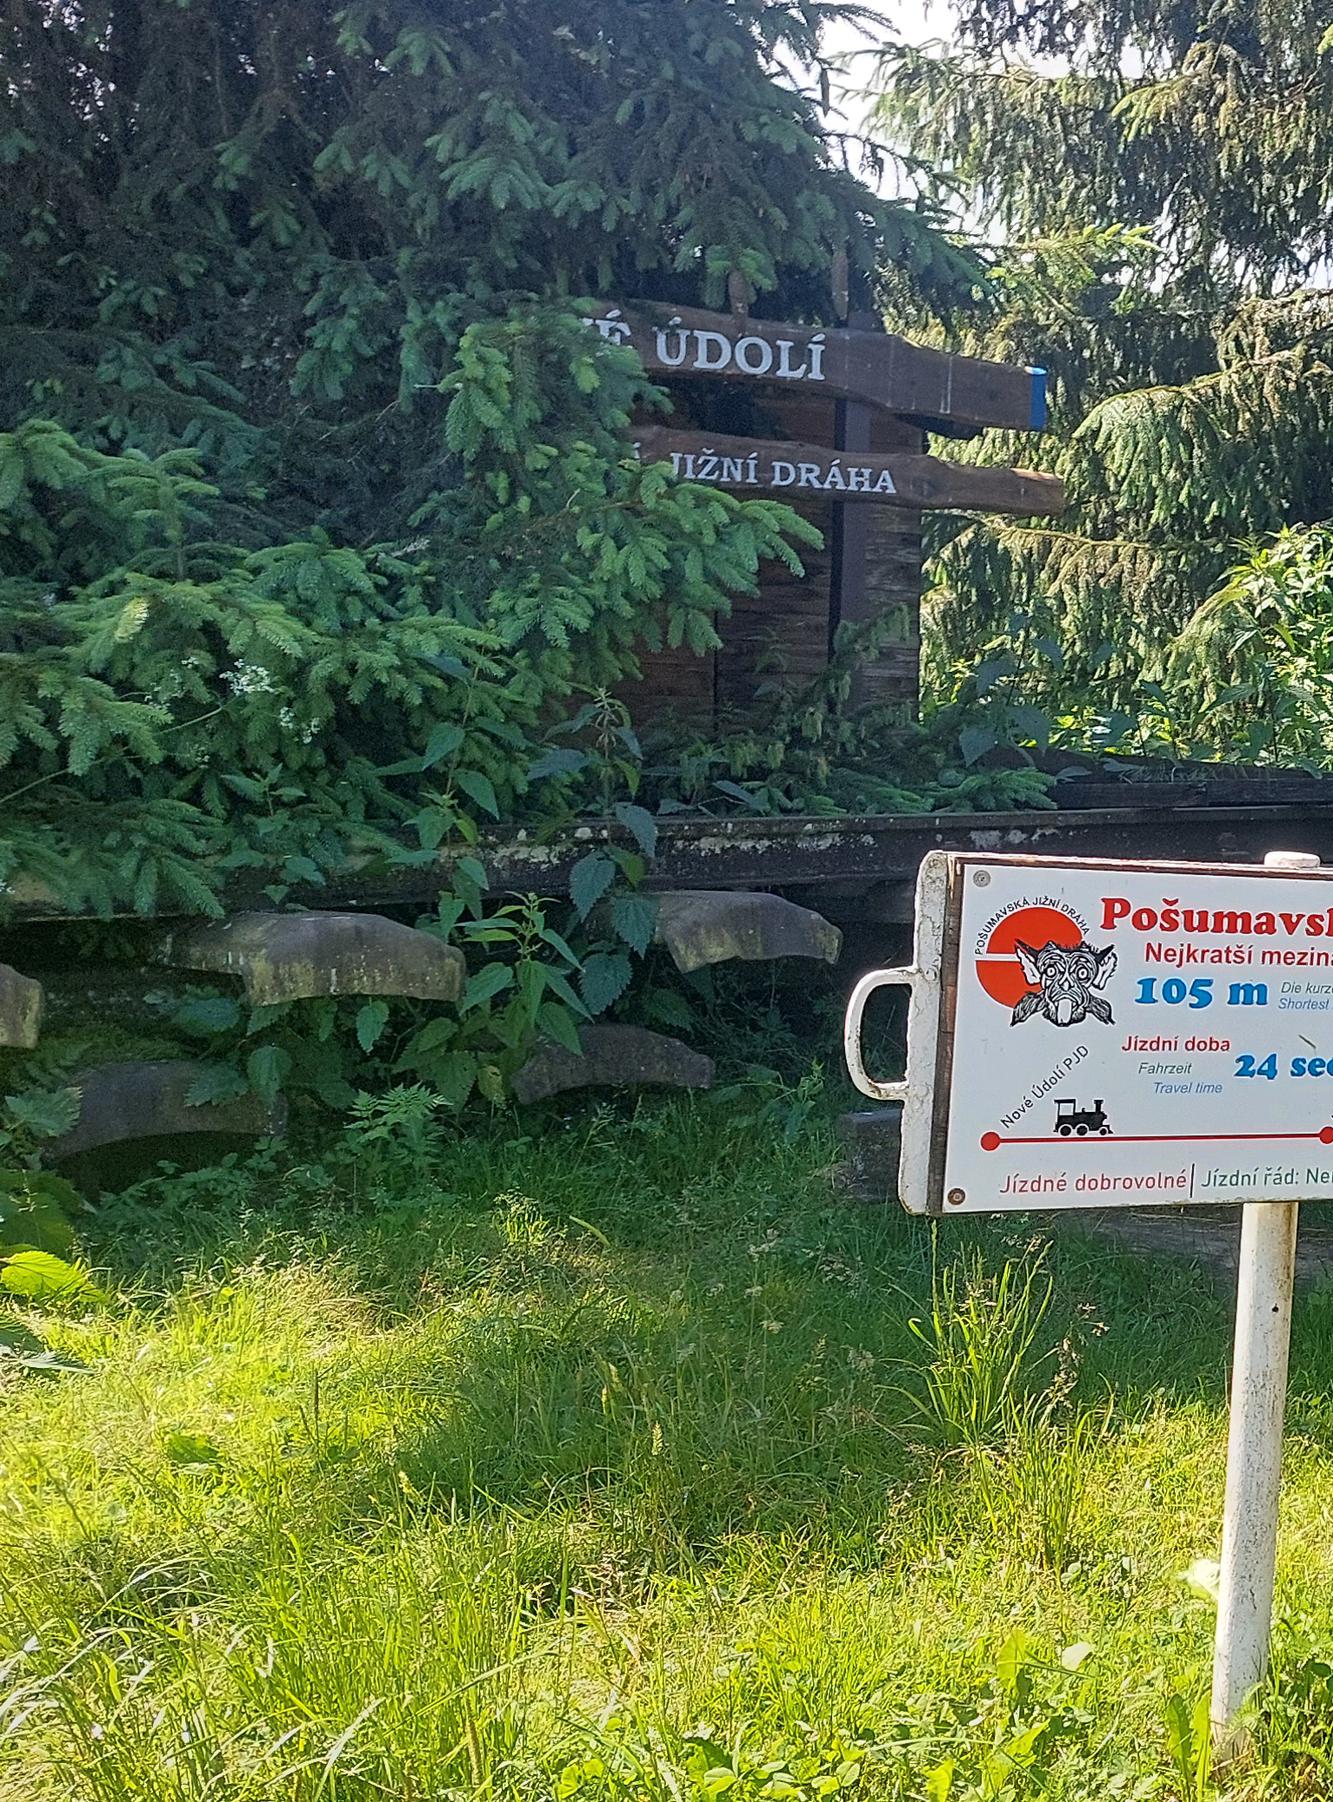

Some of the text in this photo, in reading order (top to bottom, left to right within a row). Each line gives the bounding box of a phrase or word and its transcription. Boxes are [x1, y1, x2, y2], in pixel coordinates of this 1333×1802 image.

[653, 316, 826, 381] ÚDOLÍ
[670, 448, 758, 484] JIŽNÍ
[771, 458, 897, 494] DRÁHA
[975, 896, 1090, 955] POŠUMAVSKÁ JIŽNÍ DRÁHA
[1145, 942, 1254, 968] Nejkratší
[1135, 977, 1268, 1009] 105 m
[1281, 981, 1302, 994] Die
[1278, 997, 1329, 1010] Shortest
[1121, 1035, 1231, 1052] Jízdní doba
[1138, 1061, 1193, 1075] Fahrzeit
[1233, 1053, 1279, 1080] 24
[1000, 1045, 1089, 1129] Nové Údolí PJD
[1154, 1081, 1223, 1094] Travel time
[1000, 1169, 1187, 1194] Jízdné dobrovolné
[1201, 1167, 1259, 1188] Jízdní
[1264, 1166, 1300, 1187] řád:
